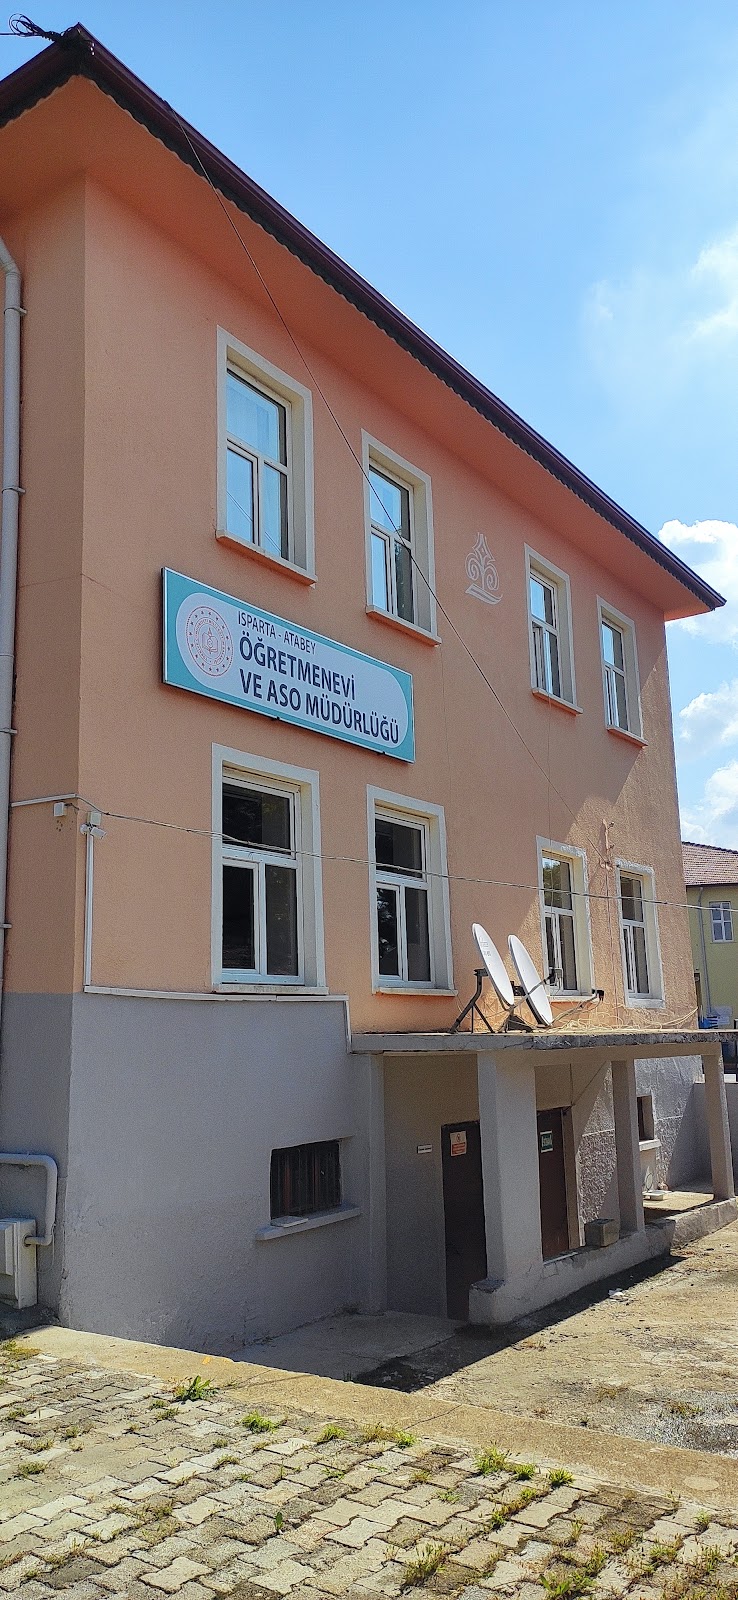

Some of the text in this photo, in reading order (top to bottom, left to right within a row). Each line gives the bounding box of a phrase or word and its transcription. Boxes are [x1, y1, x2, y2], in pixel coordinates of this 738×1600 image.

[238, 611, 276, 639] ISPARTA
[283, 631, 316, 655] ATABEY
[239, 630, 356, 701] ÖĞRETMENEVİ
[239, 668, 399, 744] VE ASO MÜDÜRLÜĞÜ
